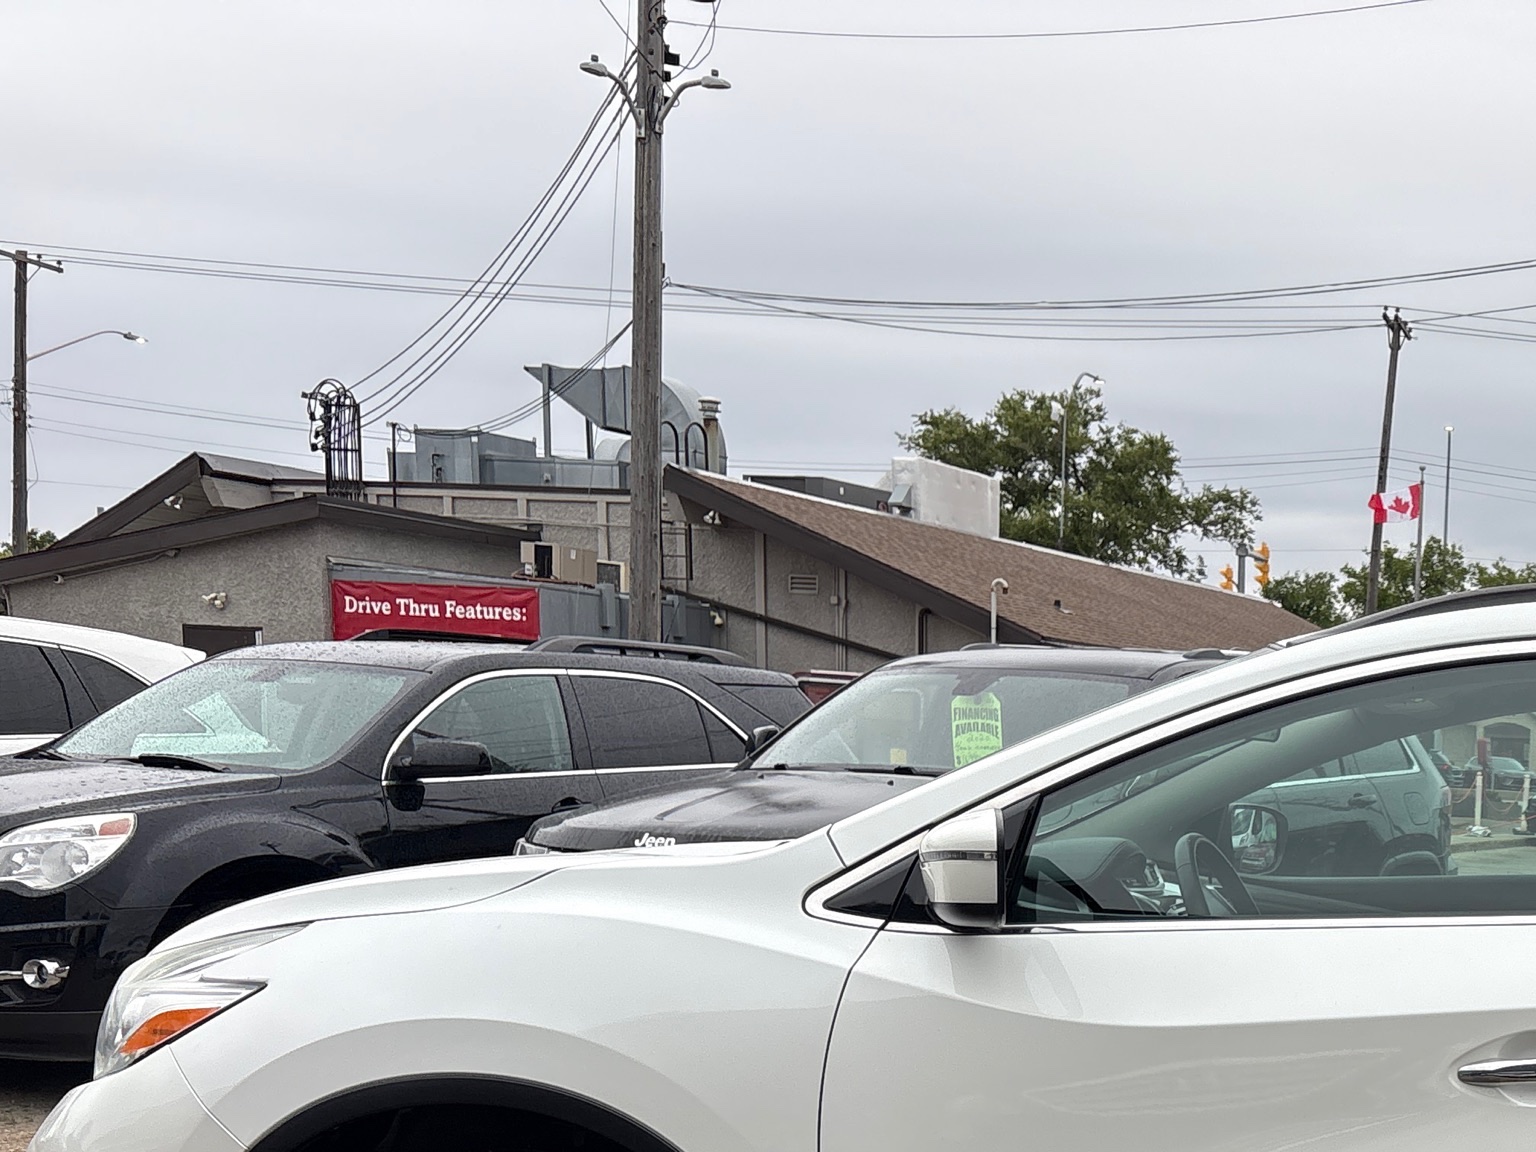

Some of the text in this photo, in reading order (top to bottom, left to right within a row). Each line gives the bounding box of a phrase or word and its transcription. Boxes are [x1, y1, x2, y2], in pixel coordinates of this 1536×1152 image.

[344, 595, 527, 621] Drive Thru Features:
[953, 707, 999, 722] FINANCING
[954, 721, 1000, 740] AVAILABLE
